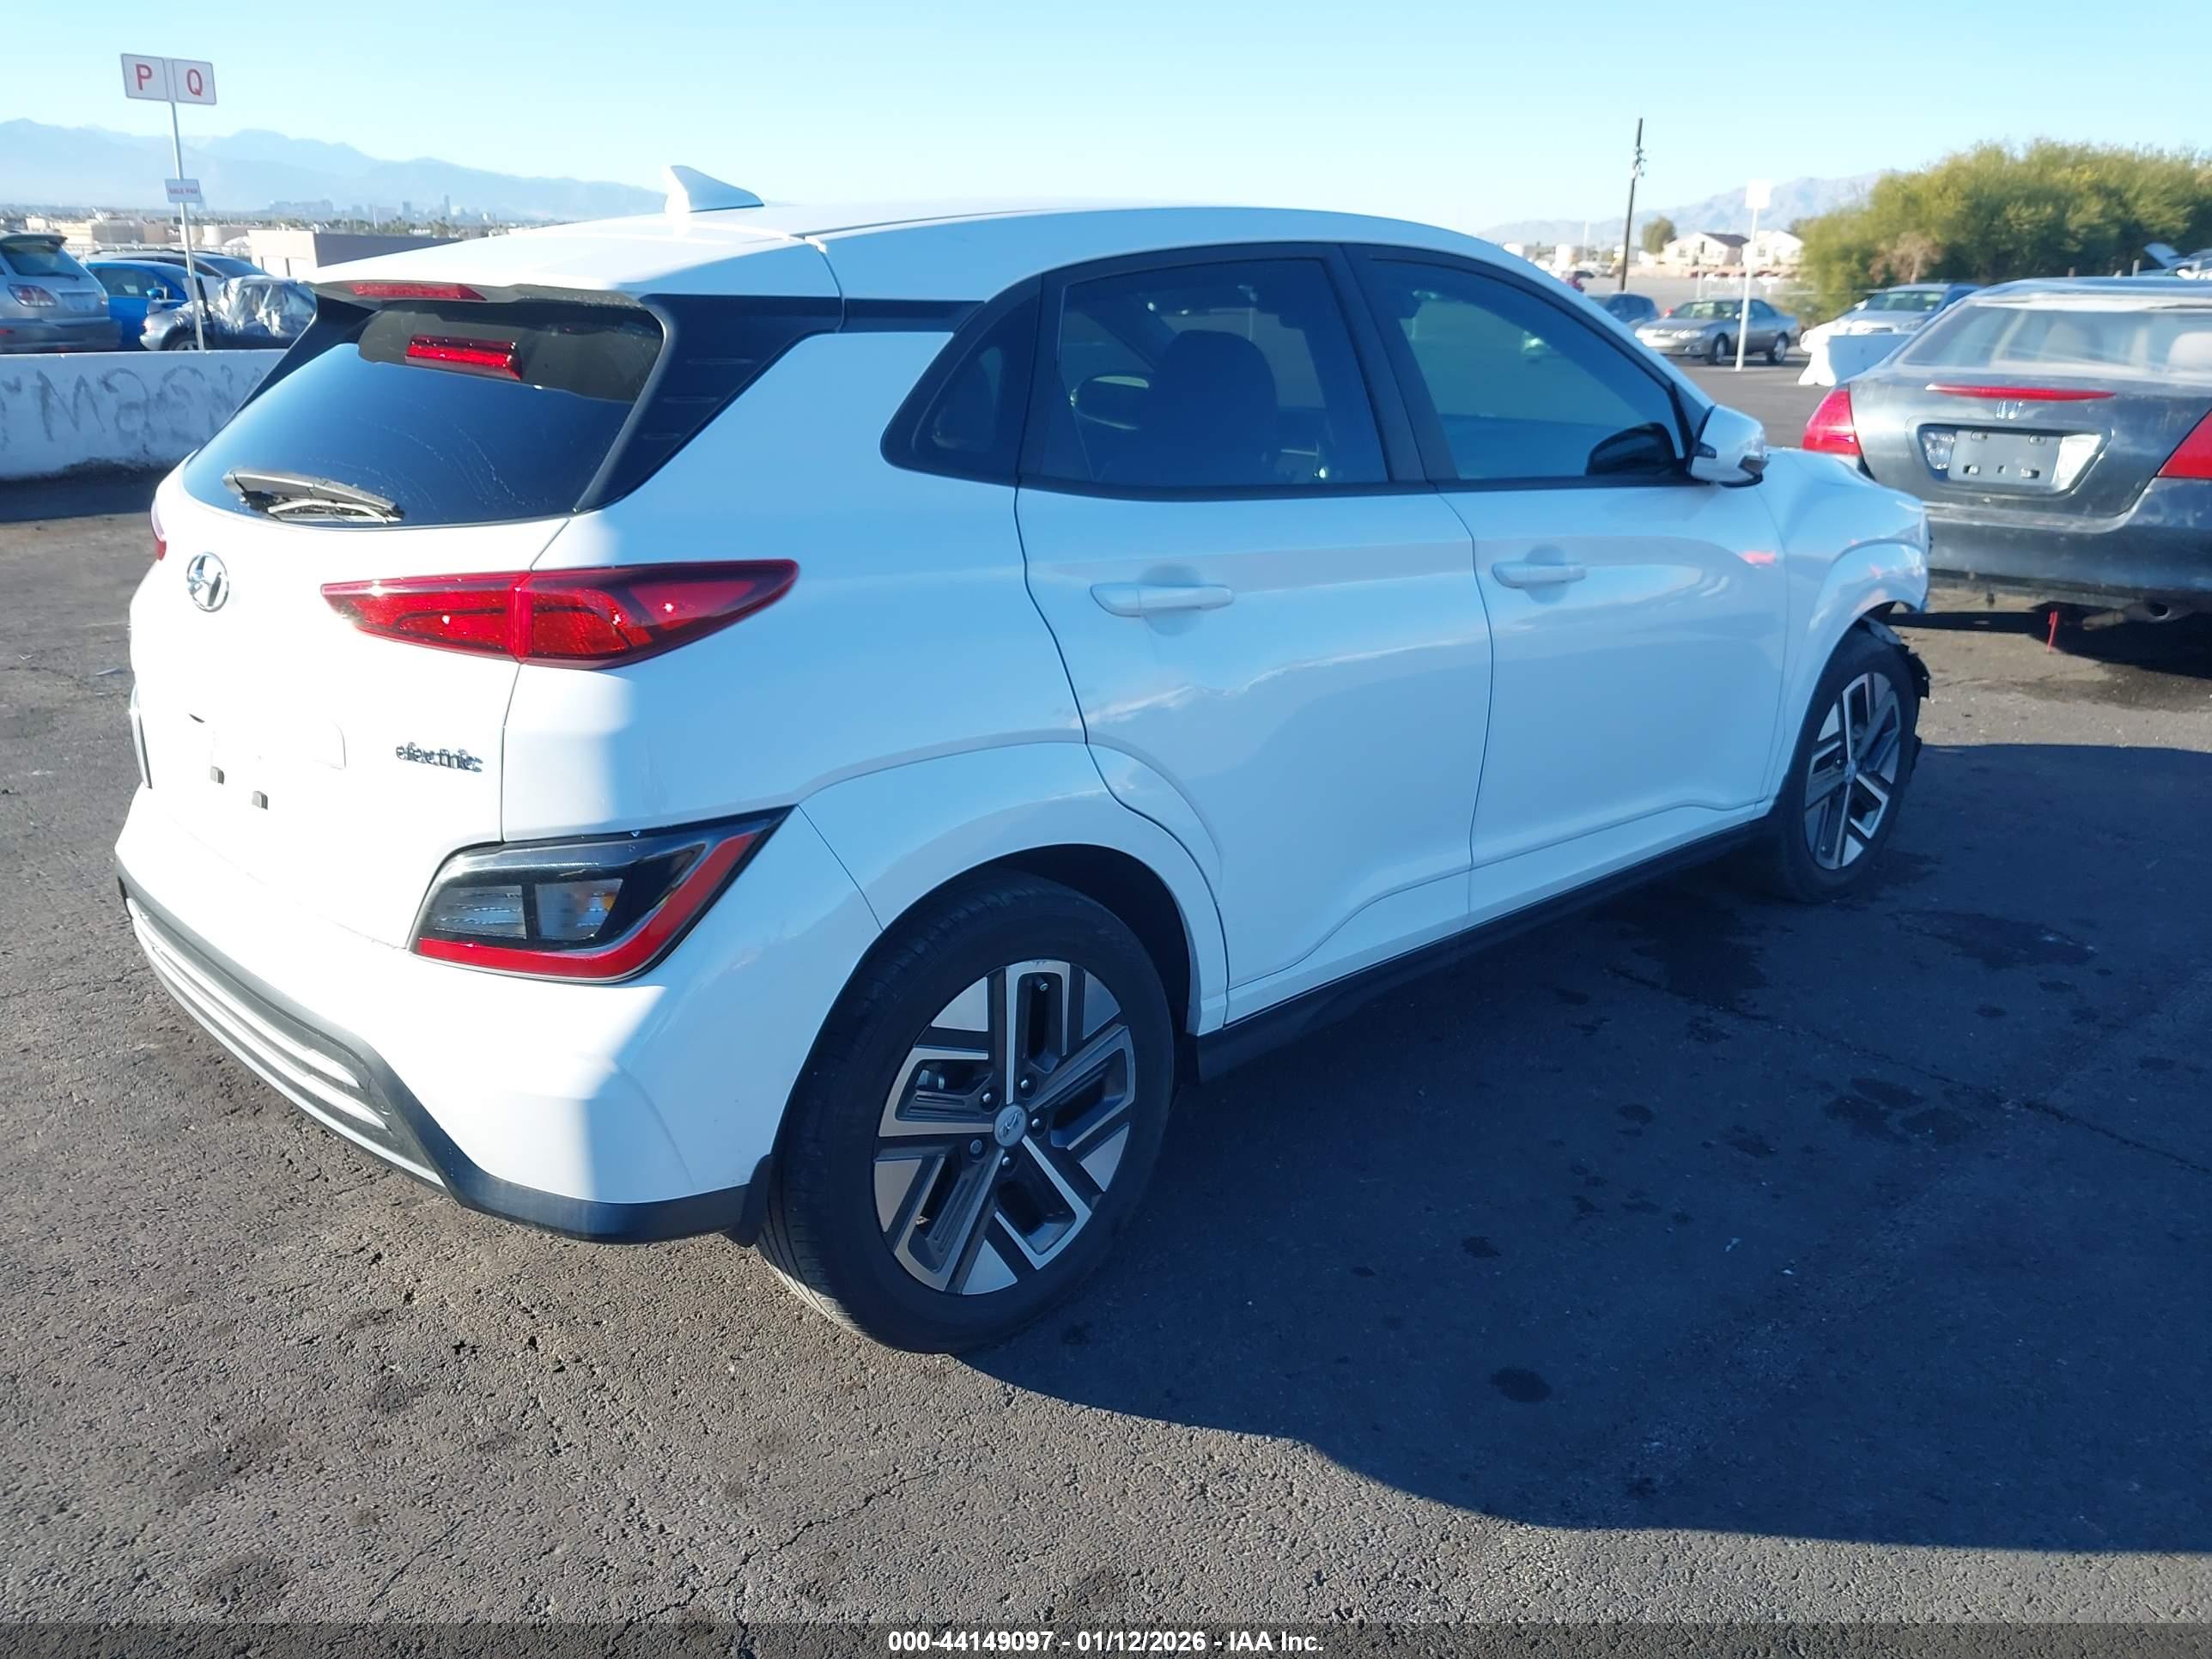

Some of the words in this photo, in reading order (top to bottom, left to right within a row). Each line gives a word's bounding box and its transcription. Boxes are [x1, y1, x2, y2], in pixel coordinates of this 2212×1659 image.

[136, 64, 152, 90] P
[186, 69, 203, 96] Q
[396, 741, 483, 772] electric
